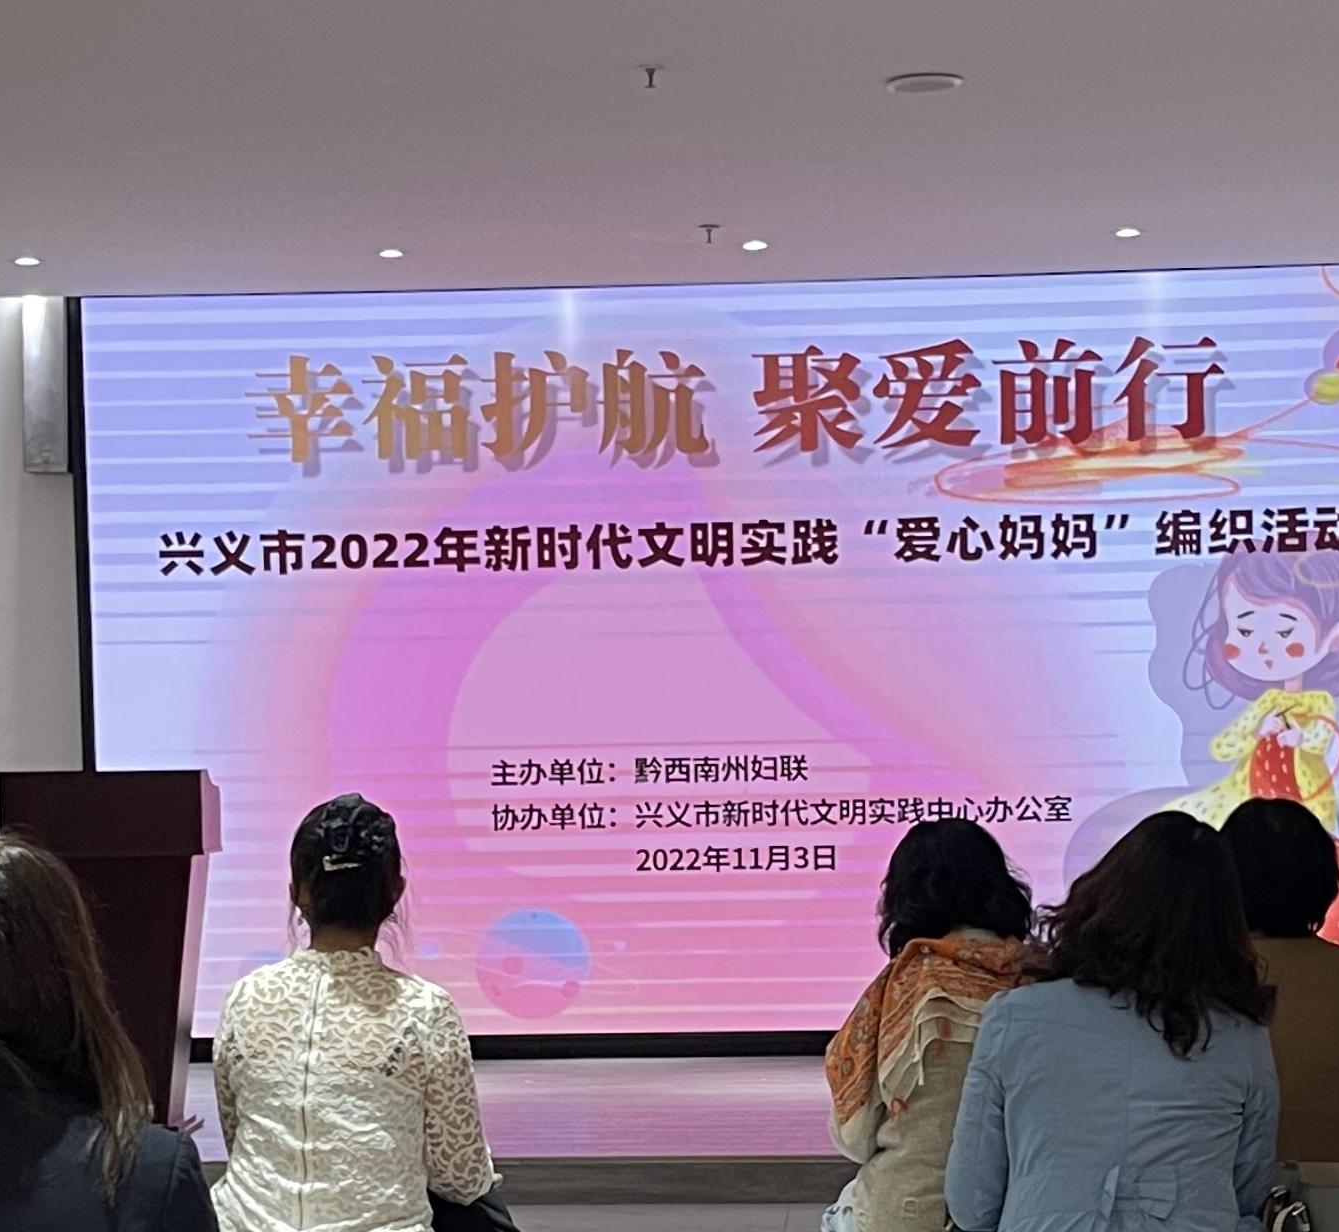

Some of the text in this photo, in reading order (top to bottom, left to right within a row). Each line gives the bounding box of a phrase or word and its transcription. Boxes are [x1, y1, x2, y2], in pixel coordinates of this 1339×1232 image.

[245, 336, 1227, 465] 幸福护航 聚爱前行
[490, 755, 809, 787] 主办单位：黔西南州妇联
[490, 795, 1073, 832] 协办单位：兴义市新时代文明实践中心办公室
[635, 845, 837, 873] 2022年11月3日
